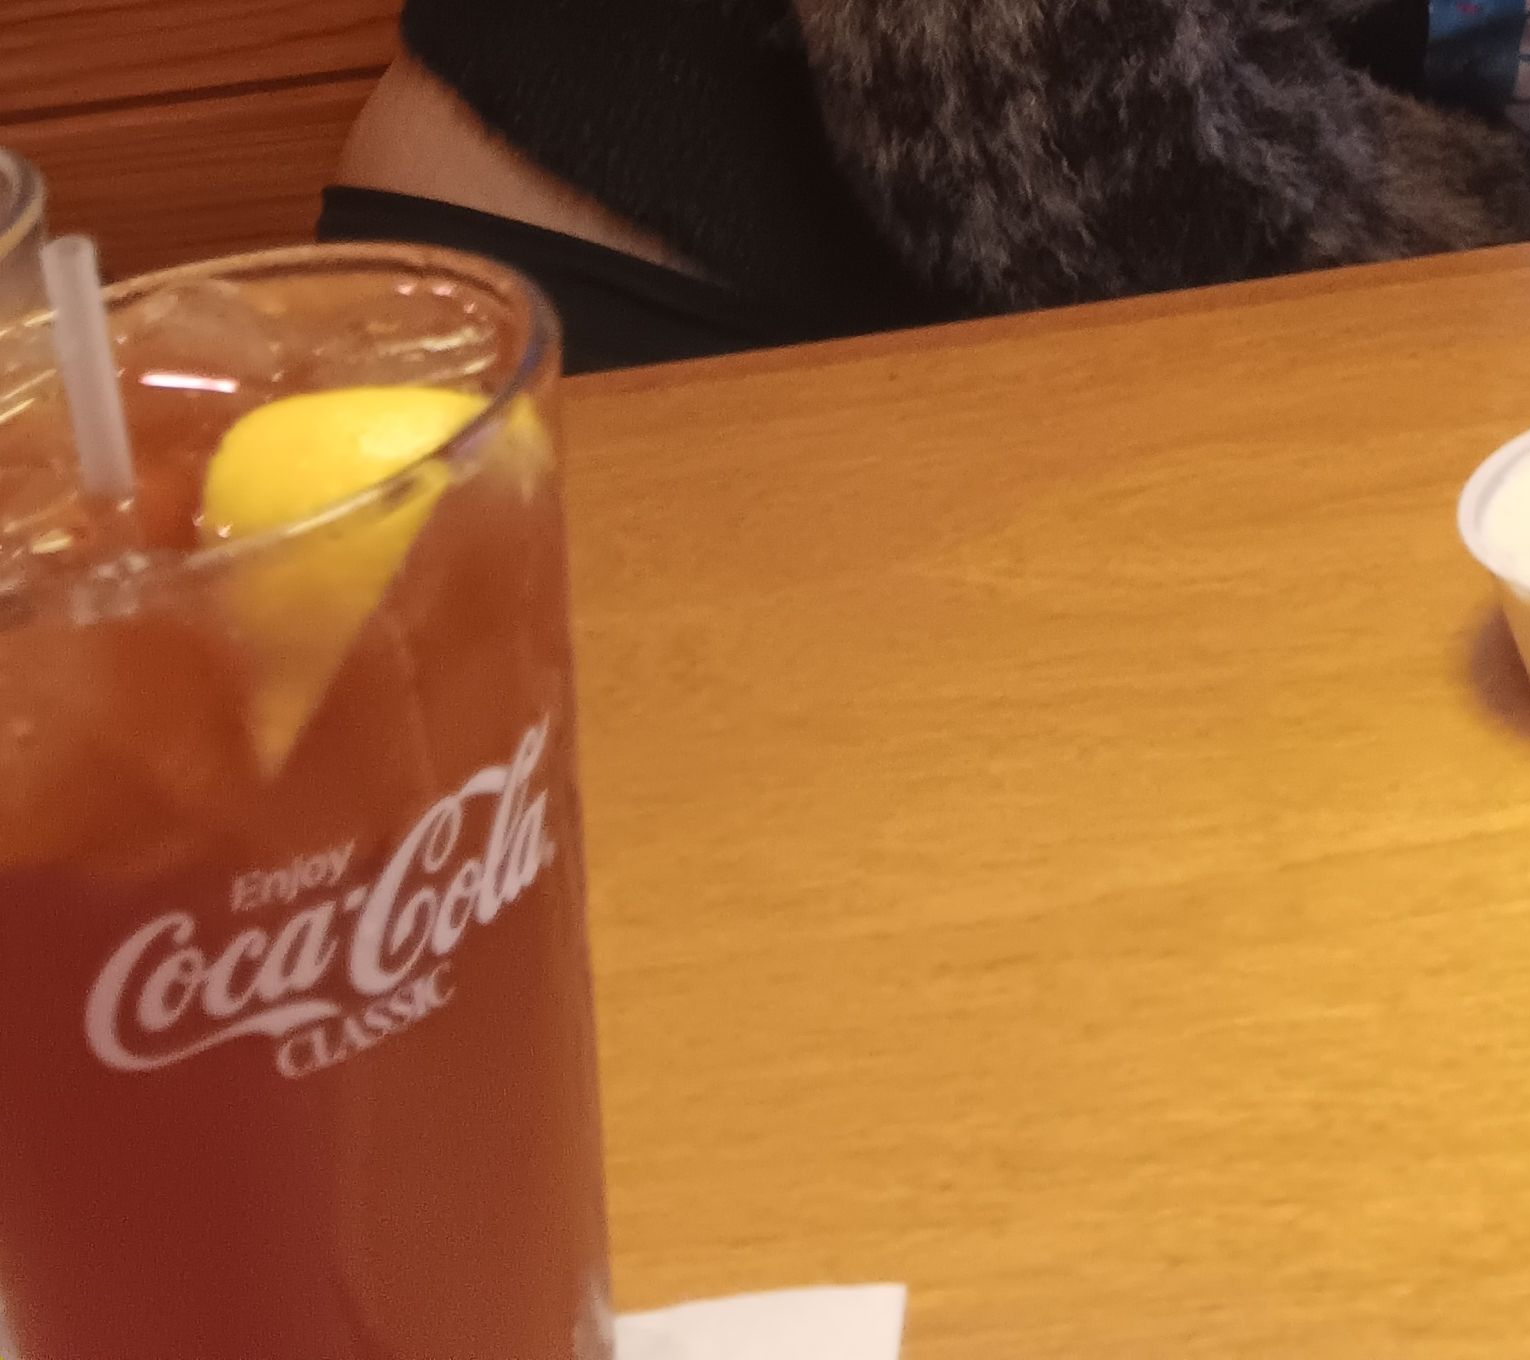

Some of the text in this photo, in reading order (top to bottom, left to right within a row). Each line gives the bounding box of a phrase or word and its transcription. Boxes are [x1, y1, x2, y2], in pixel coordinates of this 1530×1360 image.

[85, 713, 552, 1070] Coca-Cola
[230, 839, 355, 912] Enjoy
[275, 962, 456, 1078] CLASSIC
